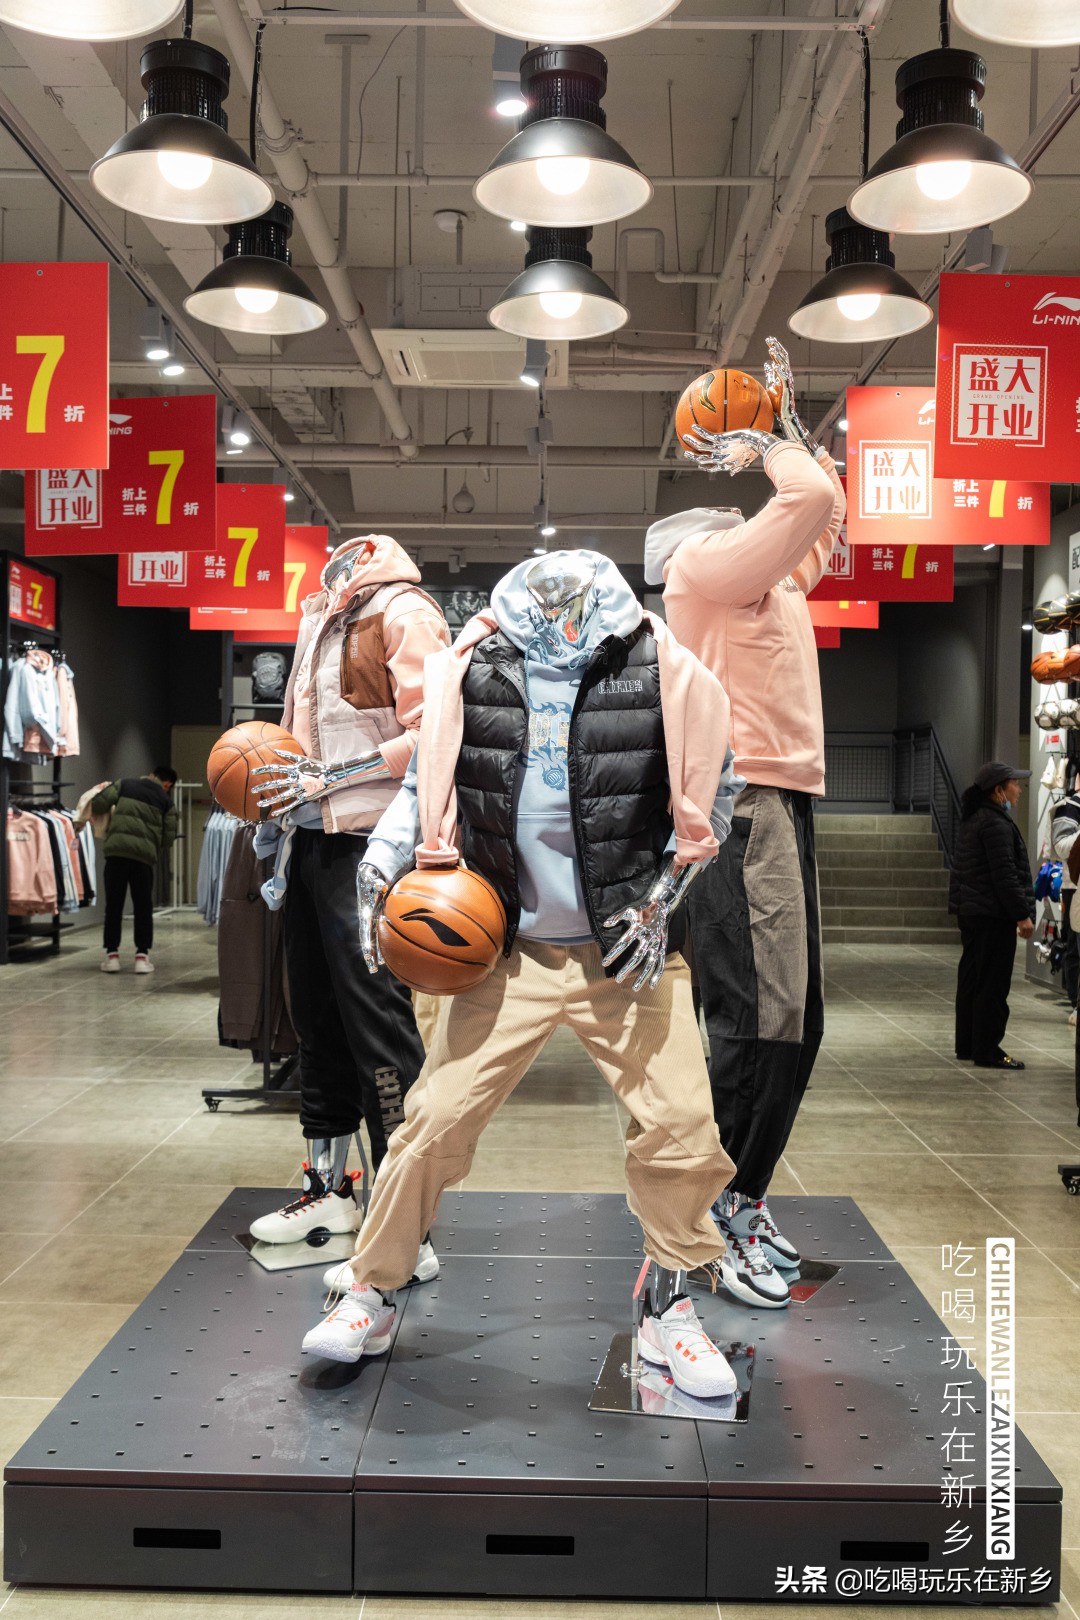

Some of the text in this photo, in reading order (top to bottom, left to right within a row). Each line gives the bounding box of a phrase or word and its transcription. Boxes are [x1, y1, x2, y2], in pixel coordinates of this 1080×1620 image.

[1032, 314, 1080, 326] LI-NIN
[16, 335, 65, 433] 7
[968, 358, 1036, 394] 盛大
[0, 383, 13, 400] 上
[0, 404, 13, 421] 件
[63, 405, 85, 422] 折
[966, 403, 1033, 437] 开业
[871, 451, 921, 477] 盛大
[121, 487, 147, 501] 折上
[148, 450, 184, 525] 7
[952, 479, 980, 493] 折上
[872, 486, 921, 511] 开业
[953, 495, 980, 508] 三件
[1016, 496, 1034, 510] 折
[47, 496, 93, 522] 开业
[122, 503, 147, 516] 三件
[183, 502, 199, 516] 折
[204, 555, 226, 567] 折上
[227, 528, 259, 587] 7
[872, 547, 894, 559] 折上
[138, 560, 180, 581] 开业
[204, 568, 226, 579] 三件
[872, 560, 894, 571] 三件
[925, 561, 939, 573] 折
[256, 569, 271, 582] 折
[30, 581, 43, 609] 7
[284, 562, 307, 613] 7
